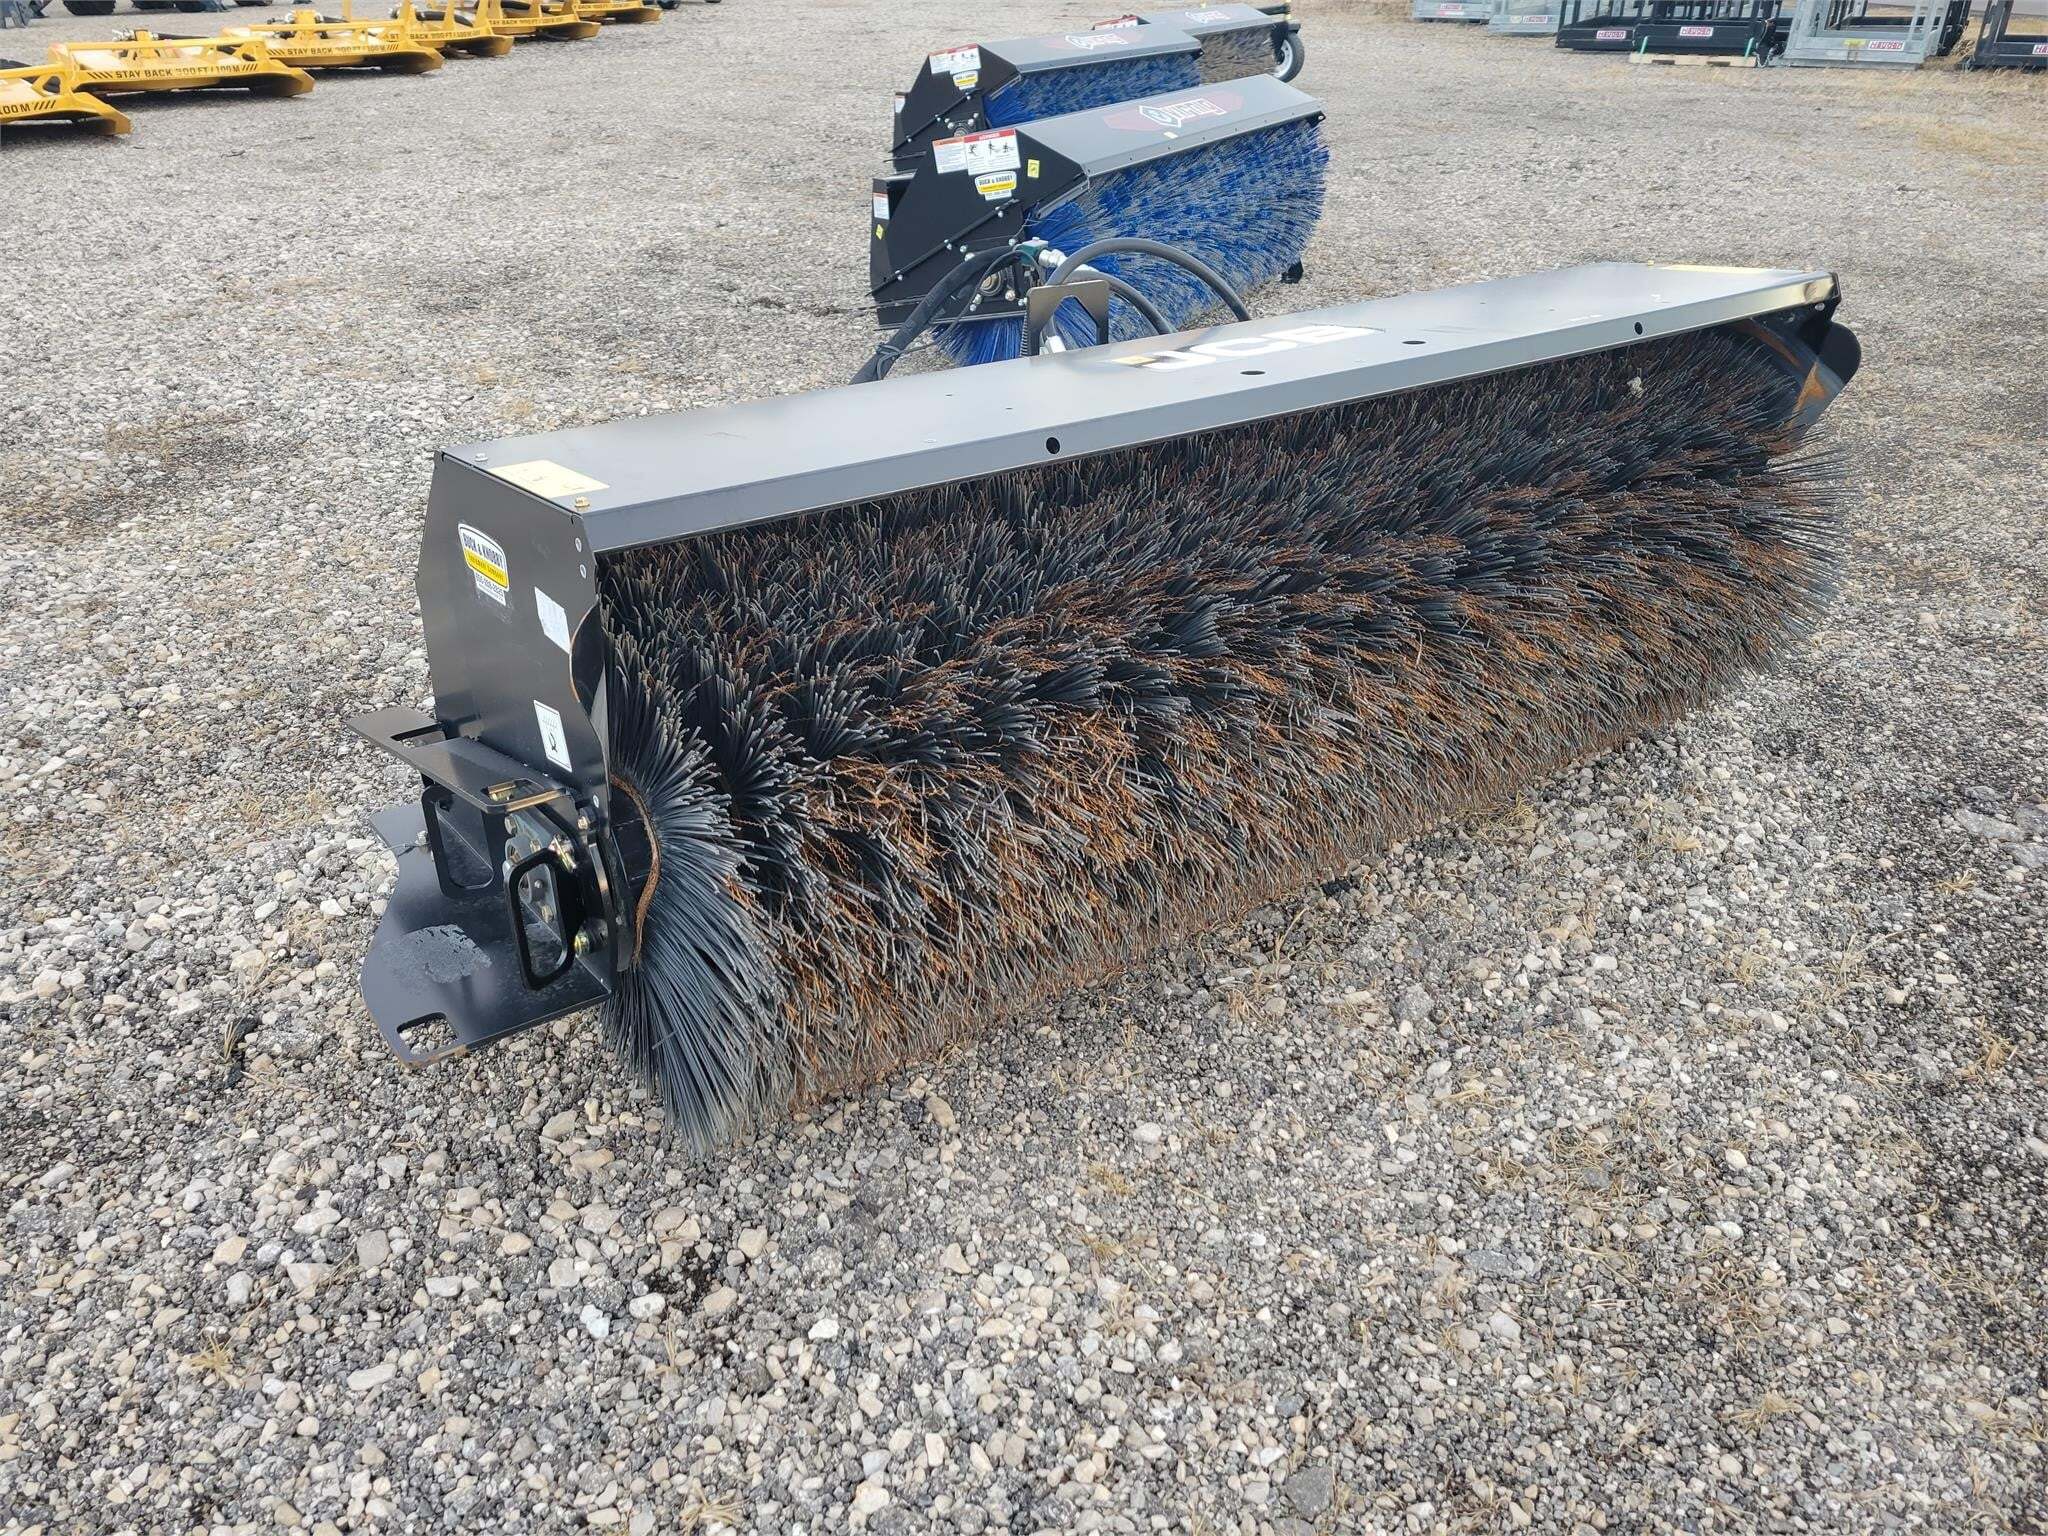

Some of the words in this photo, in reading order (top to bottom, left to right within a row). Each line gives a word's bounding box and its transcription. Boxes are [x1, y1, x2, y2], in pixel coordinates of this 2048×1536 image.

[287, 47, 308, 56] STAY
[311, 46, 333, 55] BACK
[115, 70, 141, 79] STAY
[145, 68, 173, 78] BACK
